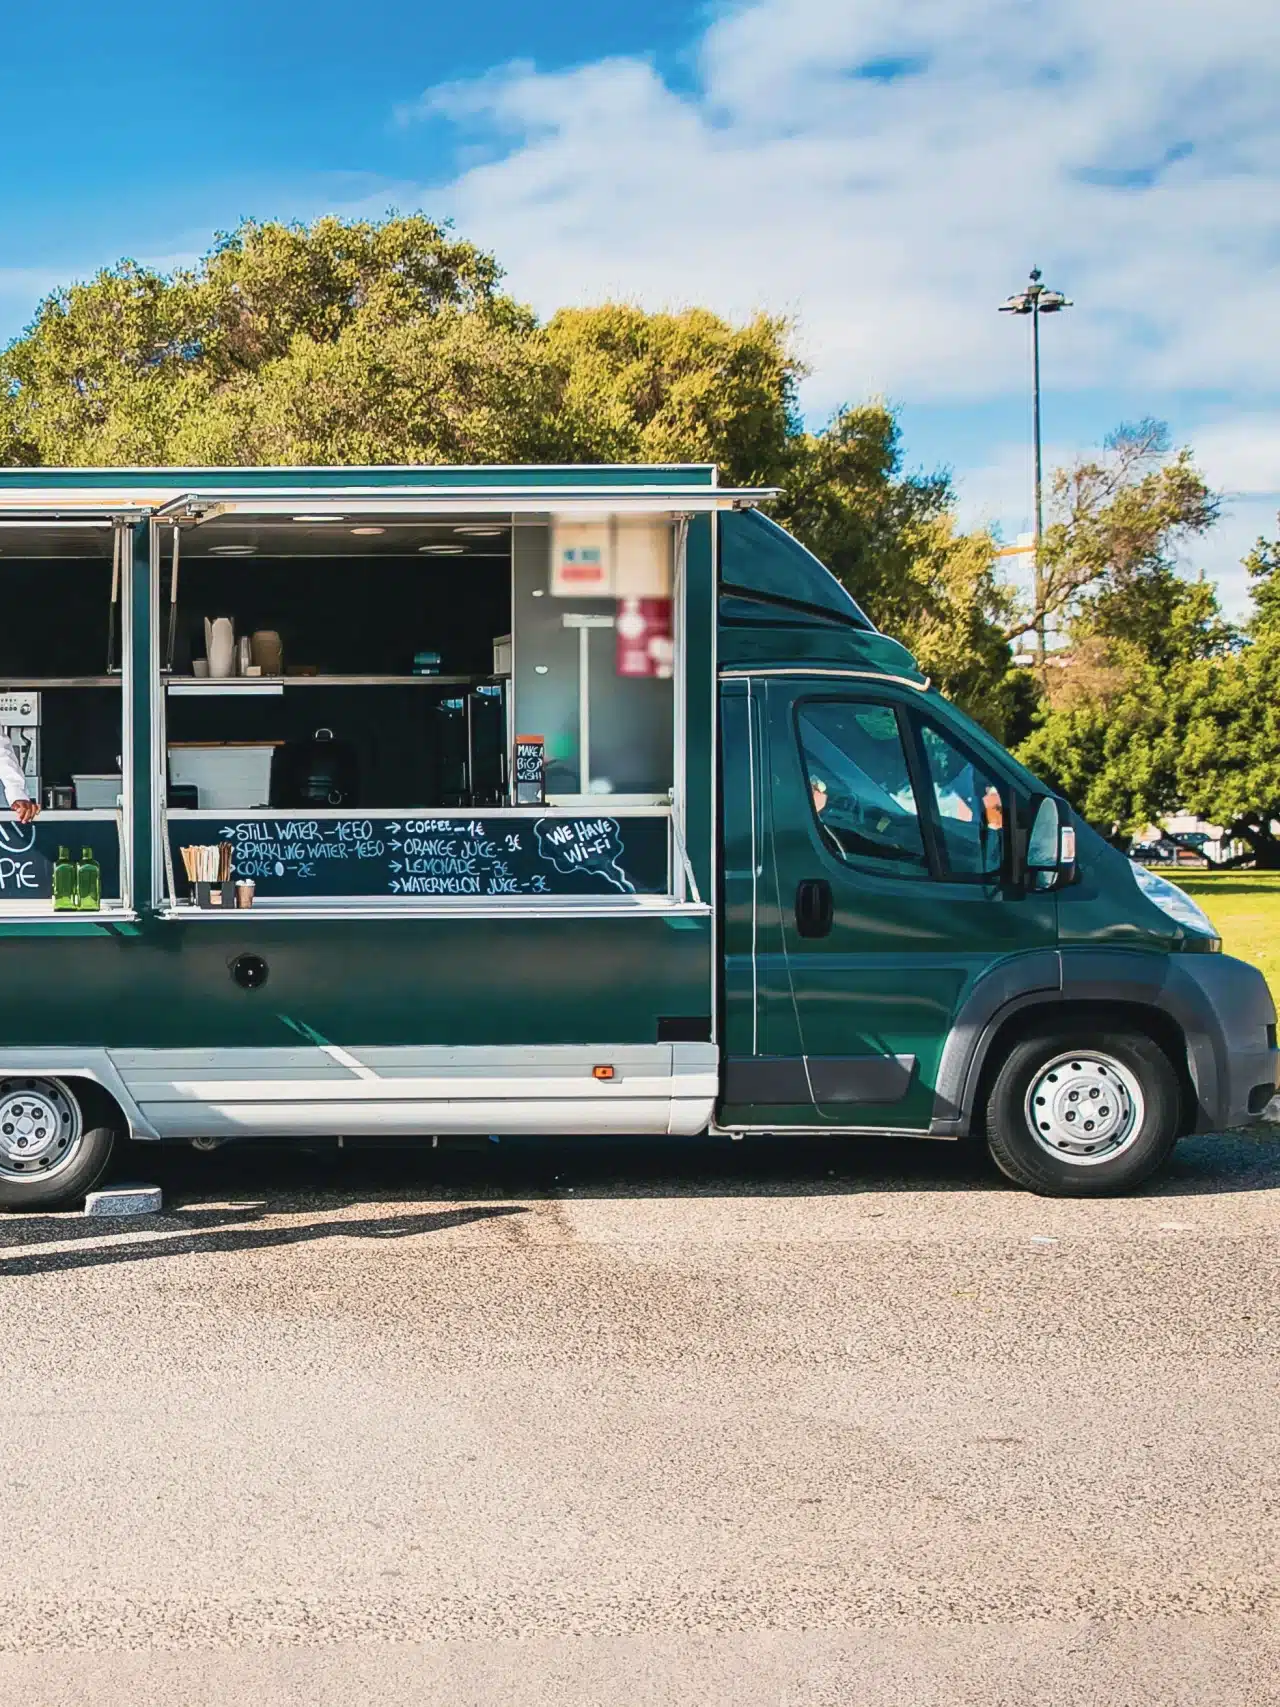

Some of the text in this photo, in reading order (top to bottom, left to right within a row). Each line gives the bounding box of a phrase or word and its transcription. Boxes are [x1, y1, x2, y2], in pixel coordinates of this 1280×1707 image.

[518, 745, 538, 757] MAKE
[275, 821, 323, 841] WATER
[405, 820, 453, 834] COFFEE
[546, 819, 612, 846] WE HAVE
[308, 842, 348, 858] WATER
[404, 840, 457, 857] ORANGE
[563, 834, 611, 864] Wi-Fi
[237, 861, 272, 877] COKE
[405, 858, 480, 875] LEMONADE
[401, 876, 481, 893] WATERMELON
